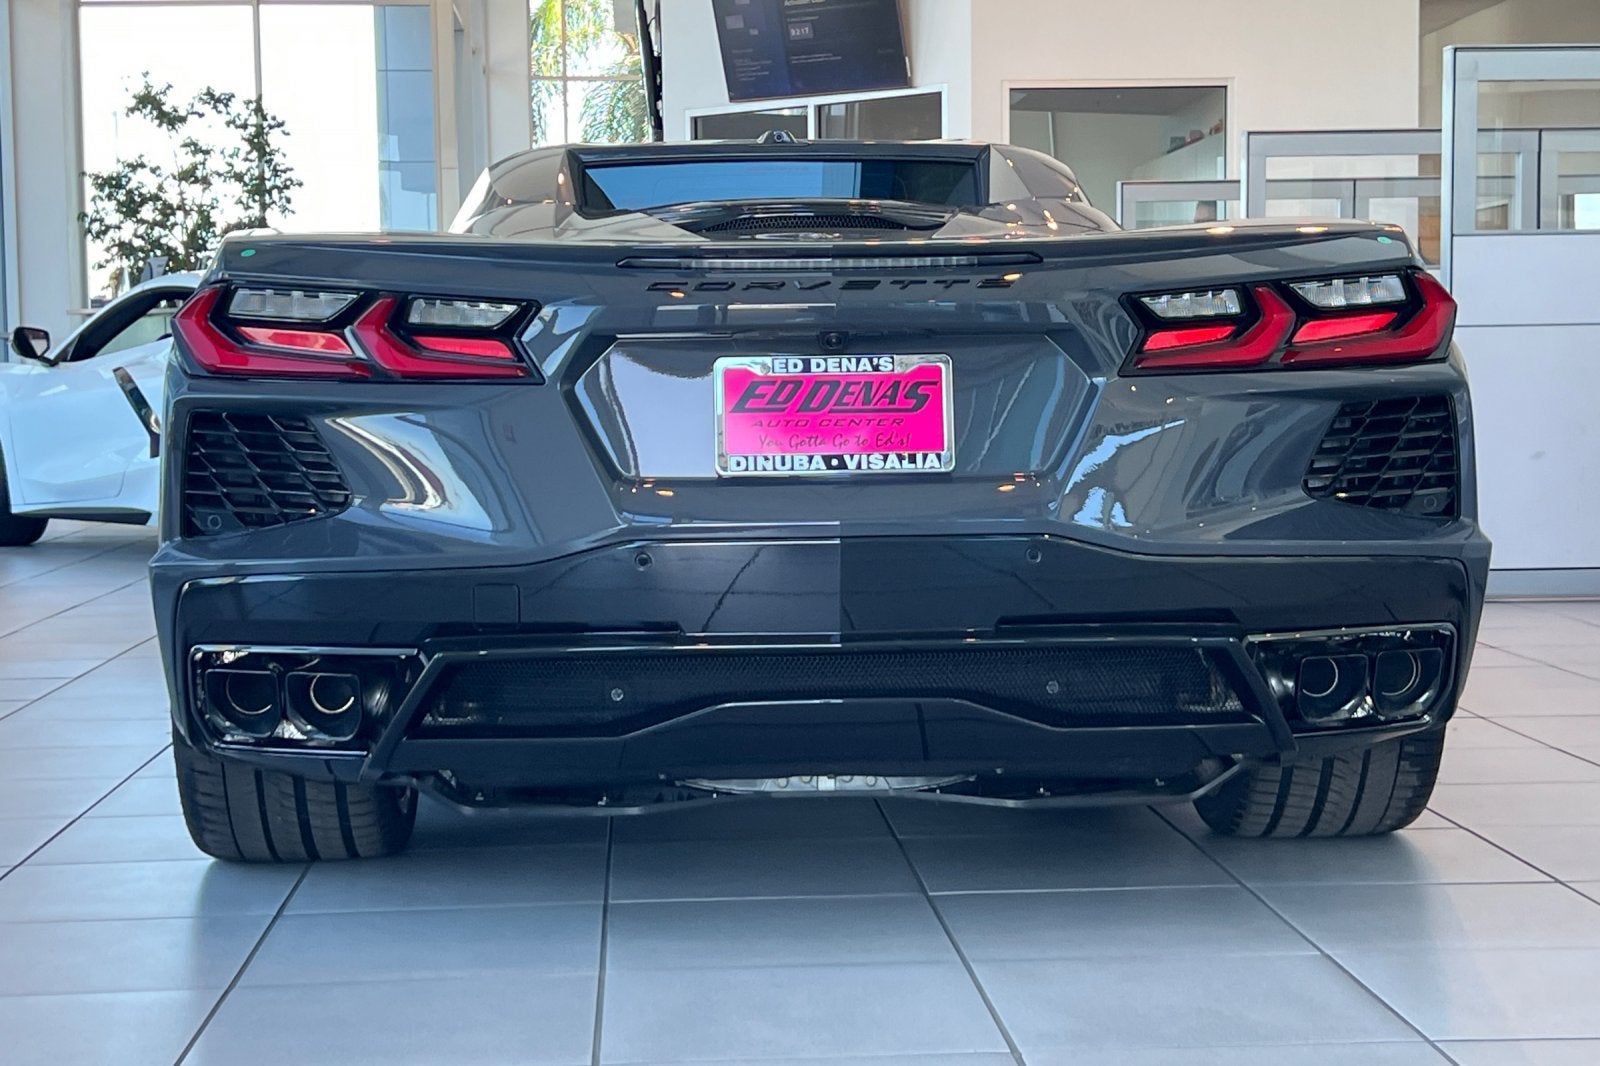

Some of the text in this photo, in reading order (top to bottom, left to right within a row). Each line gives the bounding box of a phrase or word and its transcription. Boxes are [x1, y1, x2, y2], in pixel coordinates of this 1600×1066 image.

[646, 280, 1015, 292] CORVETTE
[774, 357, 893, 372] ED DENA'S
[730, 380, 803, 413] ED
[753, 418, 904, 427] AUTO CENTER
[759, 432, 910, 450] You Gotta Go to Ed's!
[731, 453, 941, 471] DINUBA VISALIA
